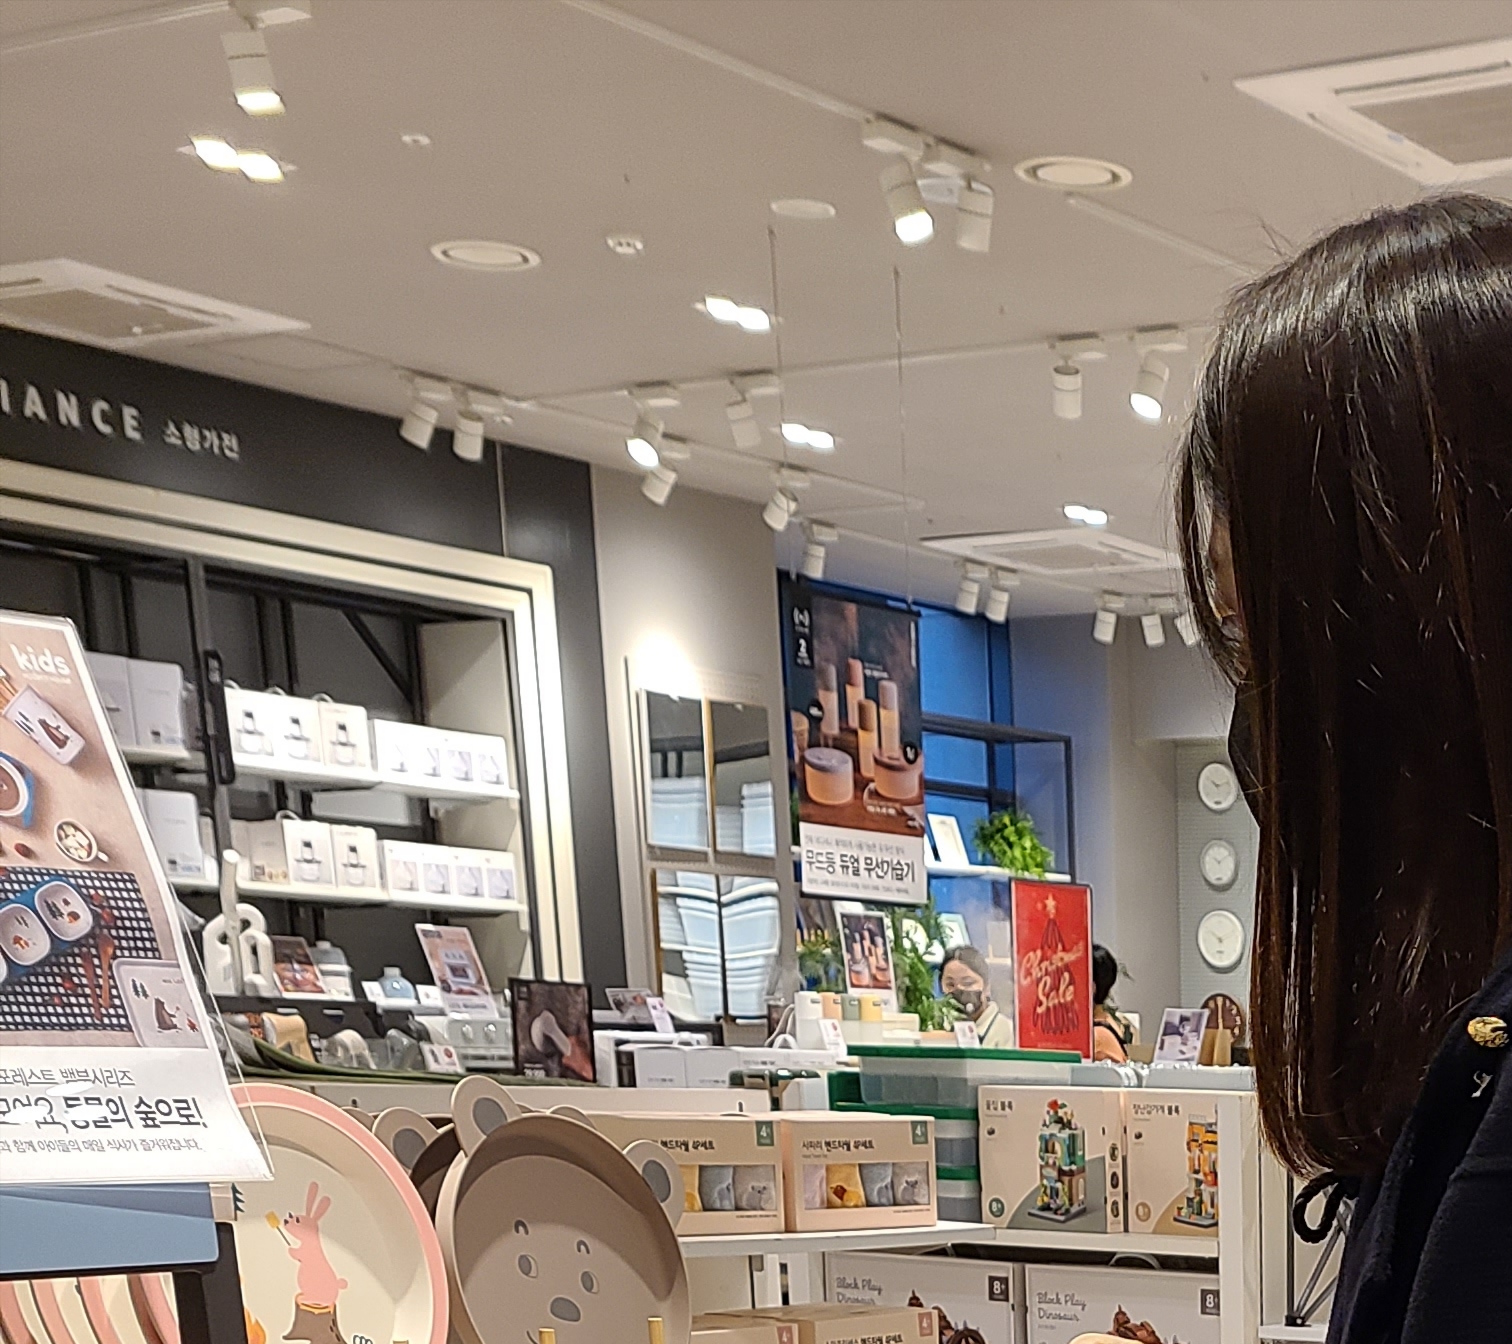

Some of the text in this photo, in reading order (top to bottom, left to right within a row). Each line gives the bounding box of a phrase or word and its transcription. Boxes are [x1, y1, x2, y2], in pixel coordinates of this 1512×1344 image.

[9, 642, 71, 675] kids
[805, 849, 836, 875] 무드등
[863, 856, 916, 883] 무선가습기
[1036, 971, 1075, 1015] Sale
[133, 1095, 208, 1129] 숲으로!
[836, 1276, 883, 1297] Block Play
[1037, 1291, 1087, 1311] Block Play
[1037, 1307, 1081, 1322] Dinosaur
